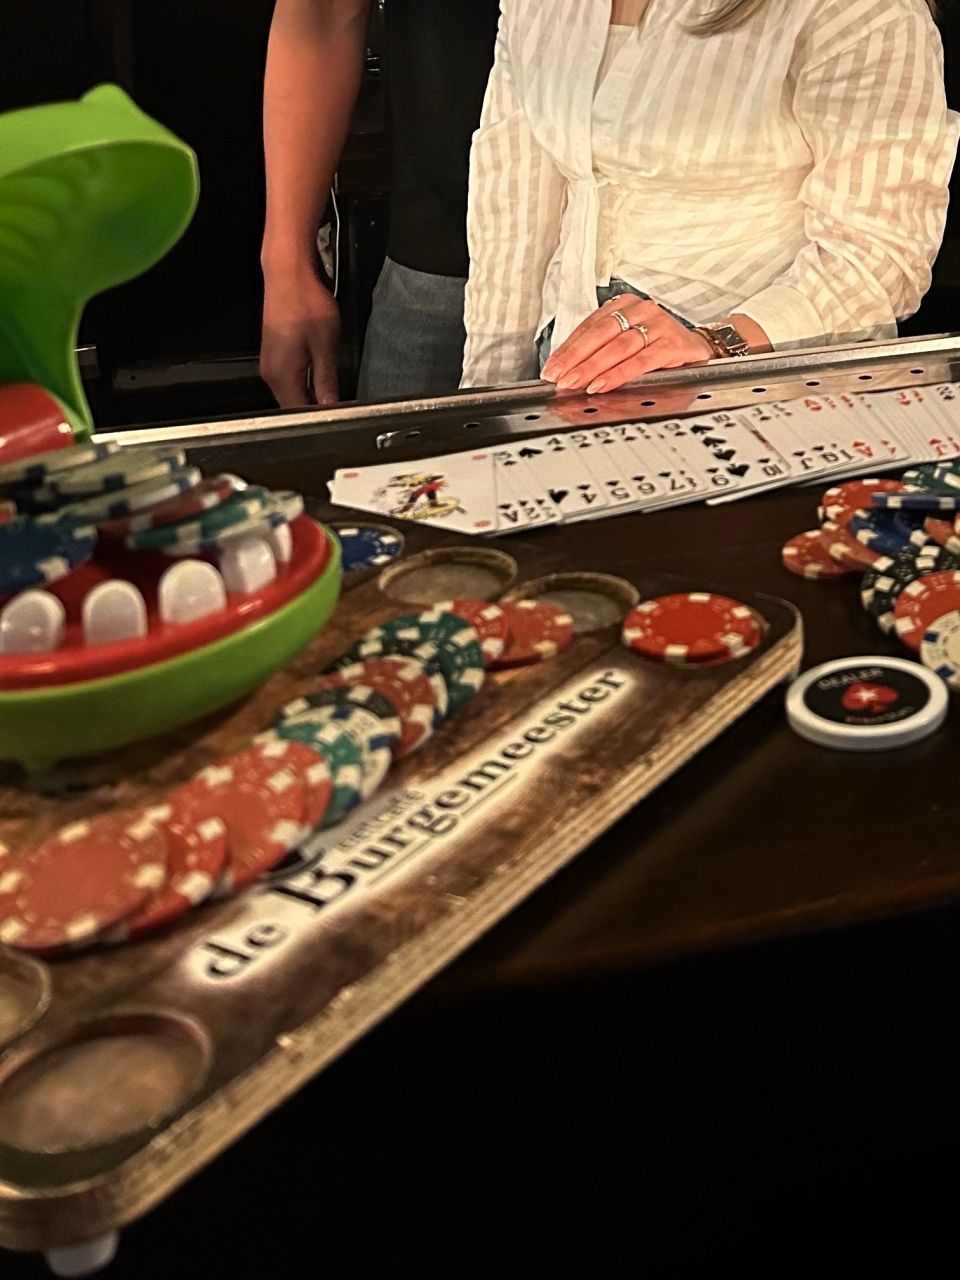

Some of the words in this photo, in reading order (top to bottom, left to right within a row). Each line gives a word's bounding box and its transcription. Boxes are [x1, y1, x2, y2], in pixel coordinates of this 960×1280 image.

[817, 668, 884, 691] DEALER
[273, 670, 630, 911] Burgemeester
[204, 922, 289, 980] de
